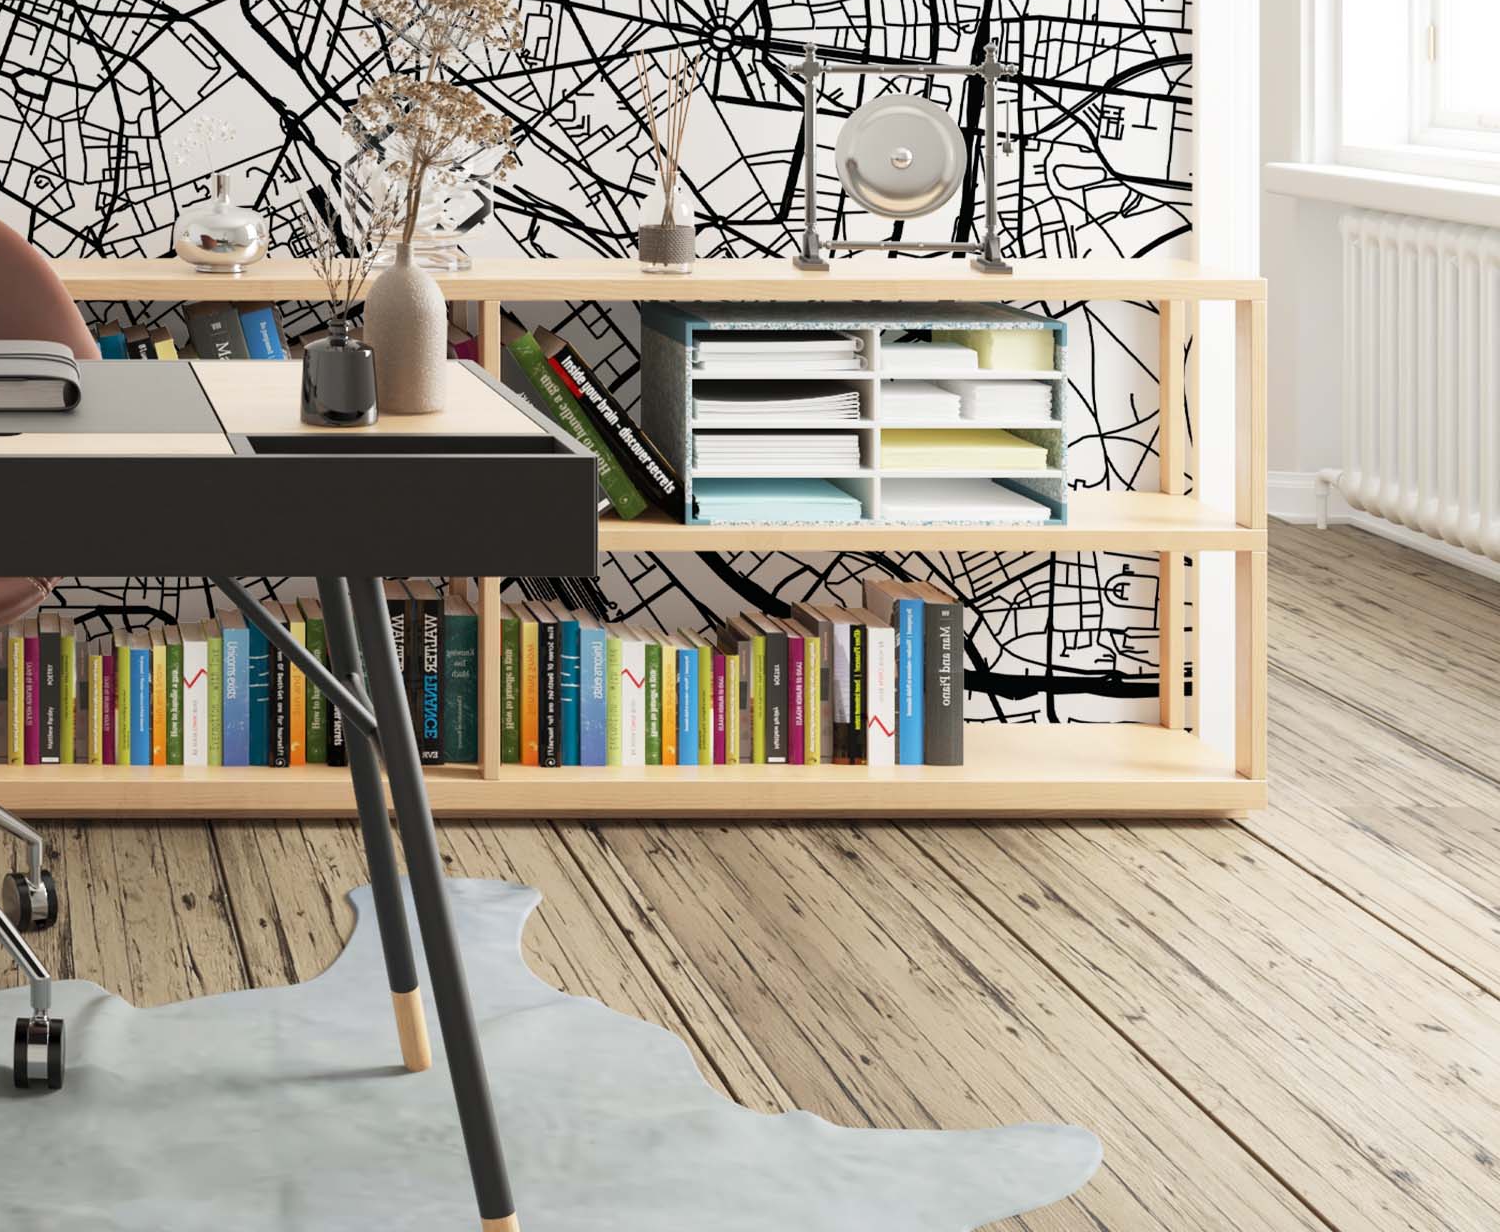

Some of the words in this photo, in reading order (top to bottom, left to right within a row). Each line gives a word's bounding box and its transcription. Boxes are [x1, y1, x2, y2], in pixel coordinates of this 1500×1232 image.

[540, 374, 560, 396] gun
[559, 404, 584, 440] handle
[560, 354, 587, 386] Inside
[578, 380, 602, 404] your
[596, 400, 619, 427] brain
[618, 426, 652, 464] discover
[644, 458, 676, 496] secrets
[170, 689, 178, 712] handle
[170, 722, 178, 737] How
[311, 711, 320, 730] How
[334, 720, 343, 746] secrets
